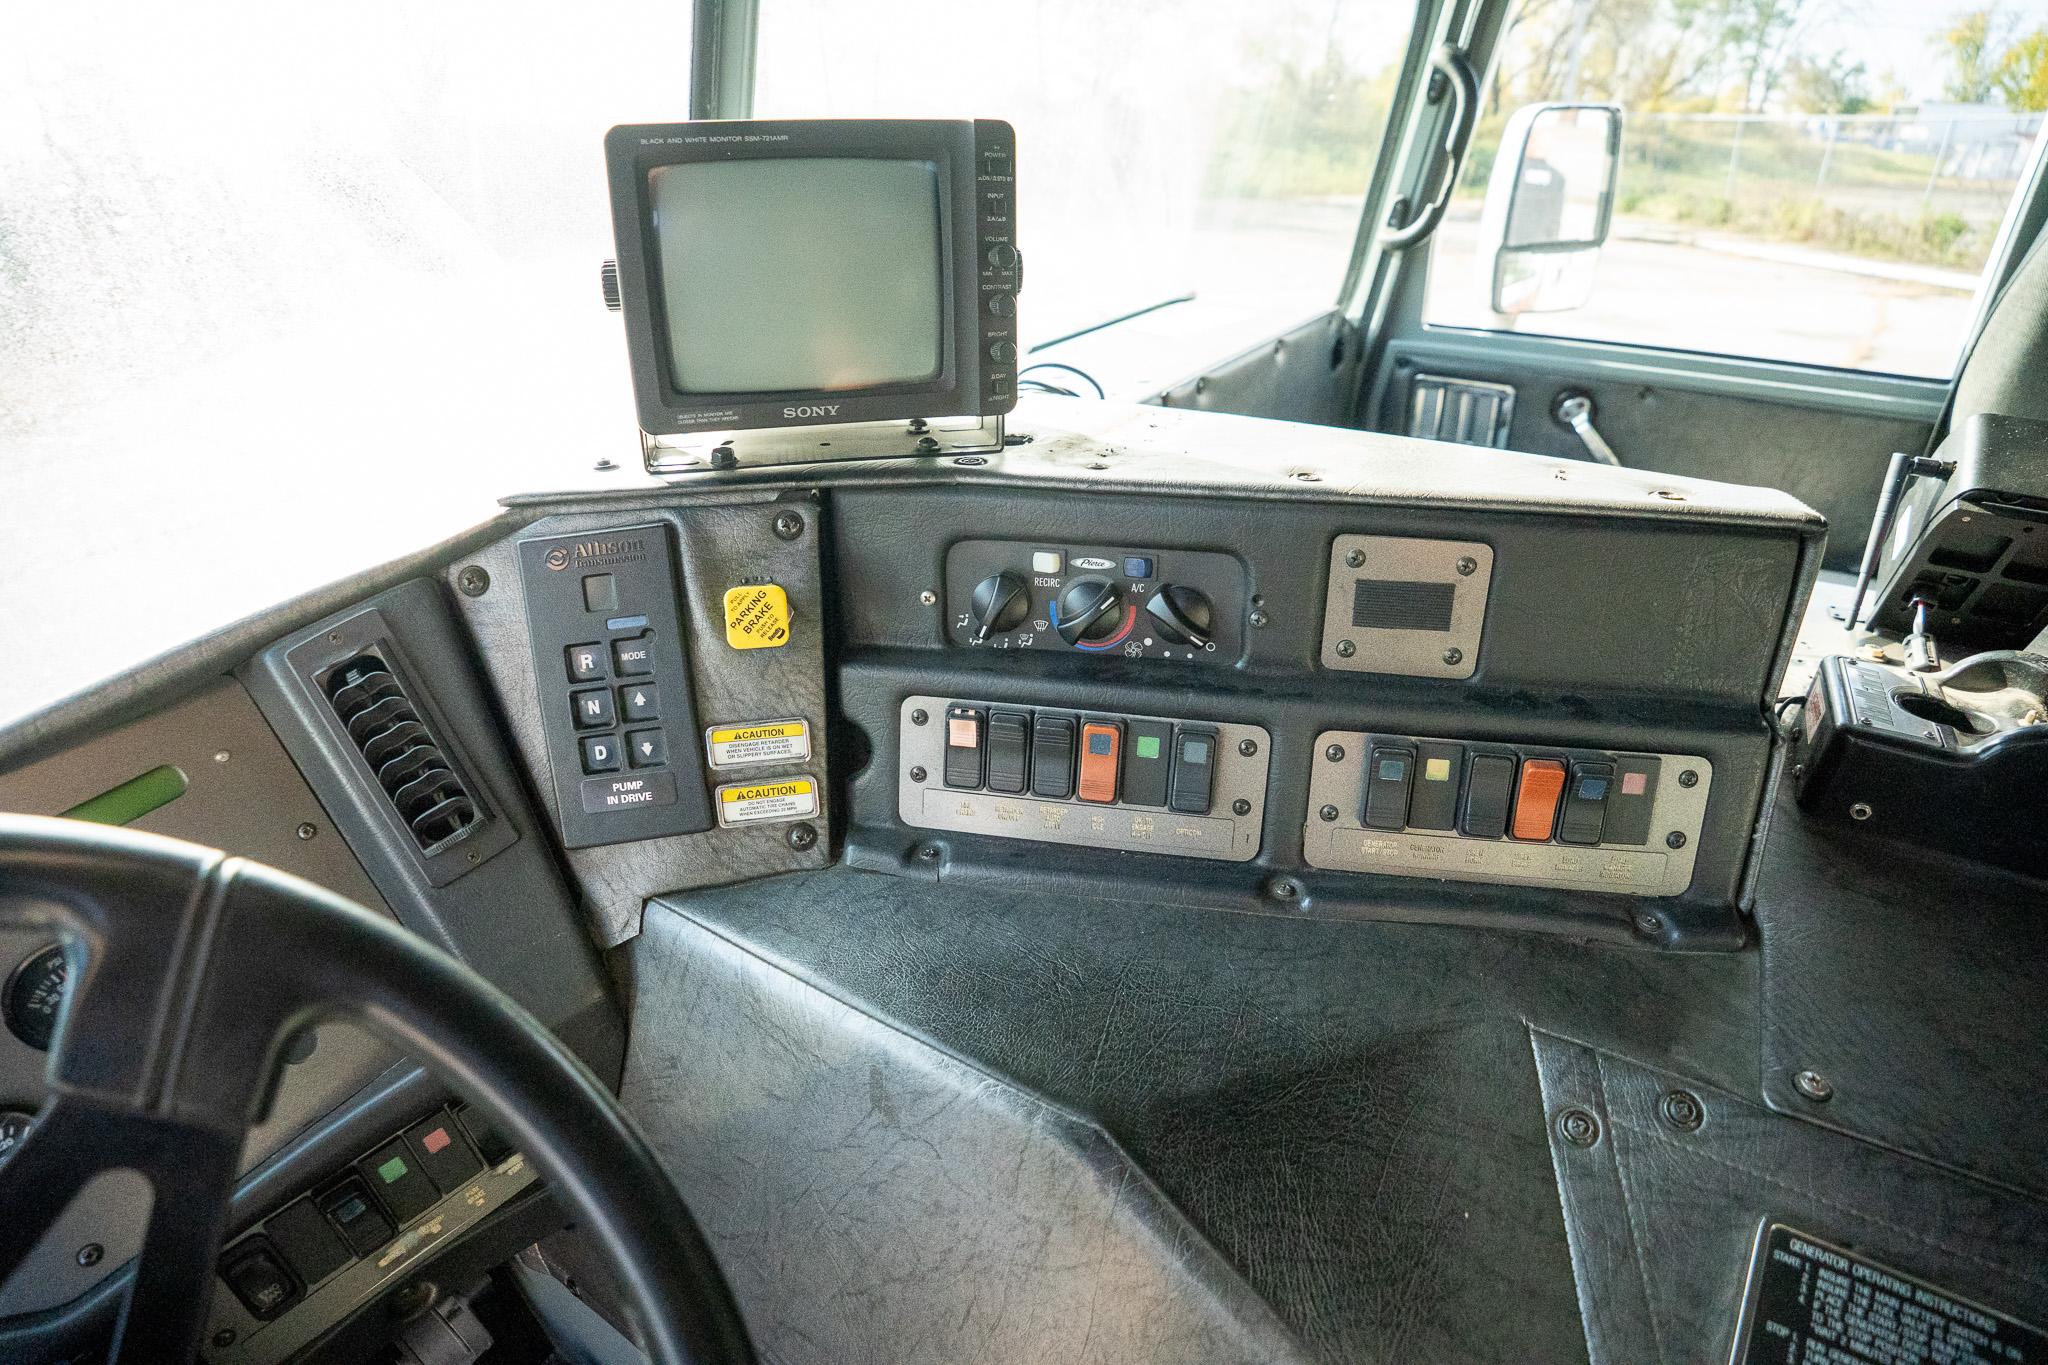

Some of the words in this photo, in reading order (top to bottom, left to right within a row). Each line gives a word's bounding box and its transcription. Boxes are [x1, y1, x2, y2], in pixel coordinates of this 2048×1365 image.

[783, 405, 840, 419] SONY
[575, 540, 645, 558] Allison
[1080, 558, 1106, 567] Pierce
[1034, 577, 1060, 588] RECIRC
[1131, 583, 1145, 593] A/C
[730, 590, 767, 630] PARKING
[742, 601, 774, 635] BRAKE
[760, 617, 780, 638] RELEASE
[580, 653, 594, 670] R
[620, 650, 646, 661] MODE
[586, 700, 600, 715] N
[742, 728, 785, 740] CAUTION
[728, 741, 760, 749] DISENGAGE
[760, 738, 790, 746] RETARDER
[594, 746, 608, 760] D
[612, 780, 644, 793] PUMP
[746, 785, 797, 800] CAUTION
[606, 794, 618, 806] IN
[620, 791, 653, 805] DRIVE
[1789, 1237, 1849, 1272] GENERATOR
[1851, 1262, 1911, 1298] OPERATING
